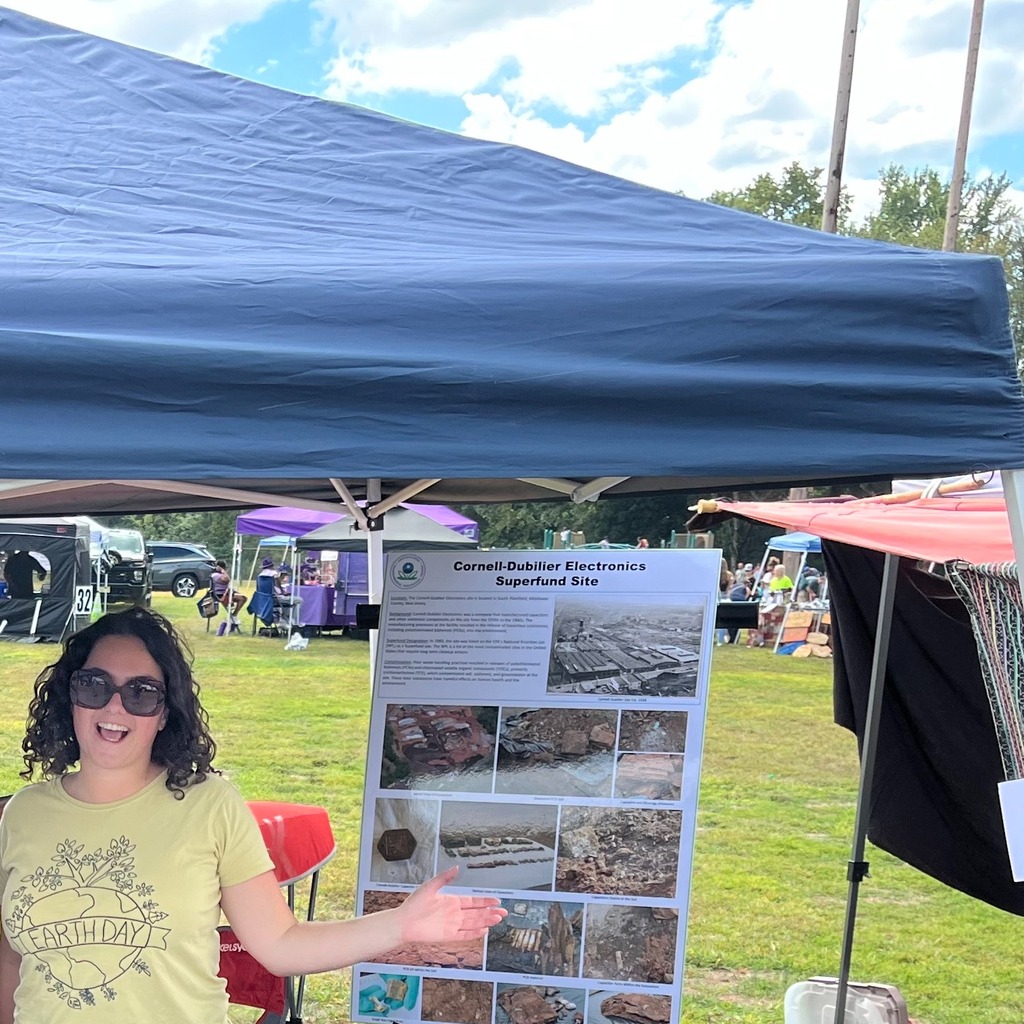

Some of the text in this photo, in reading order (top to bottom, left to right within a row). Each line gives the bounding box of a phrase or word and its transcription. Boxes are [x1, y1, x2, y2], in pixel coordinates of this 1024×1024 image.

[453, 560, 646, 572] Cornell-Dubilier Electronics
[495, 576, 599, 588] Superfund Site
[77, 588, 92, 612] 32
[28, 920, 145, 950] EARTH DAY
